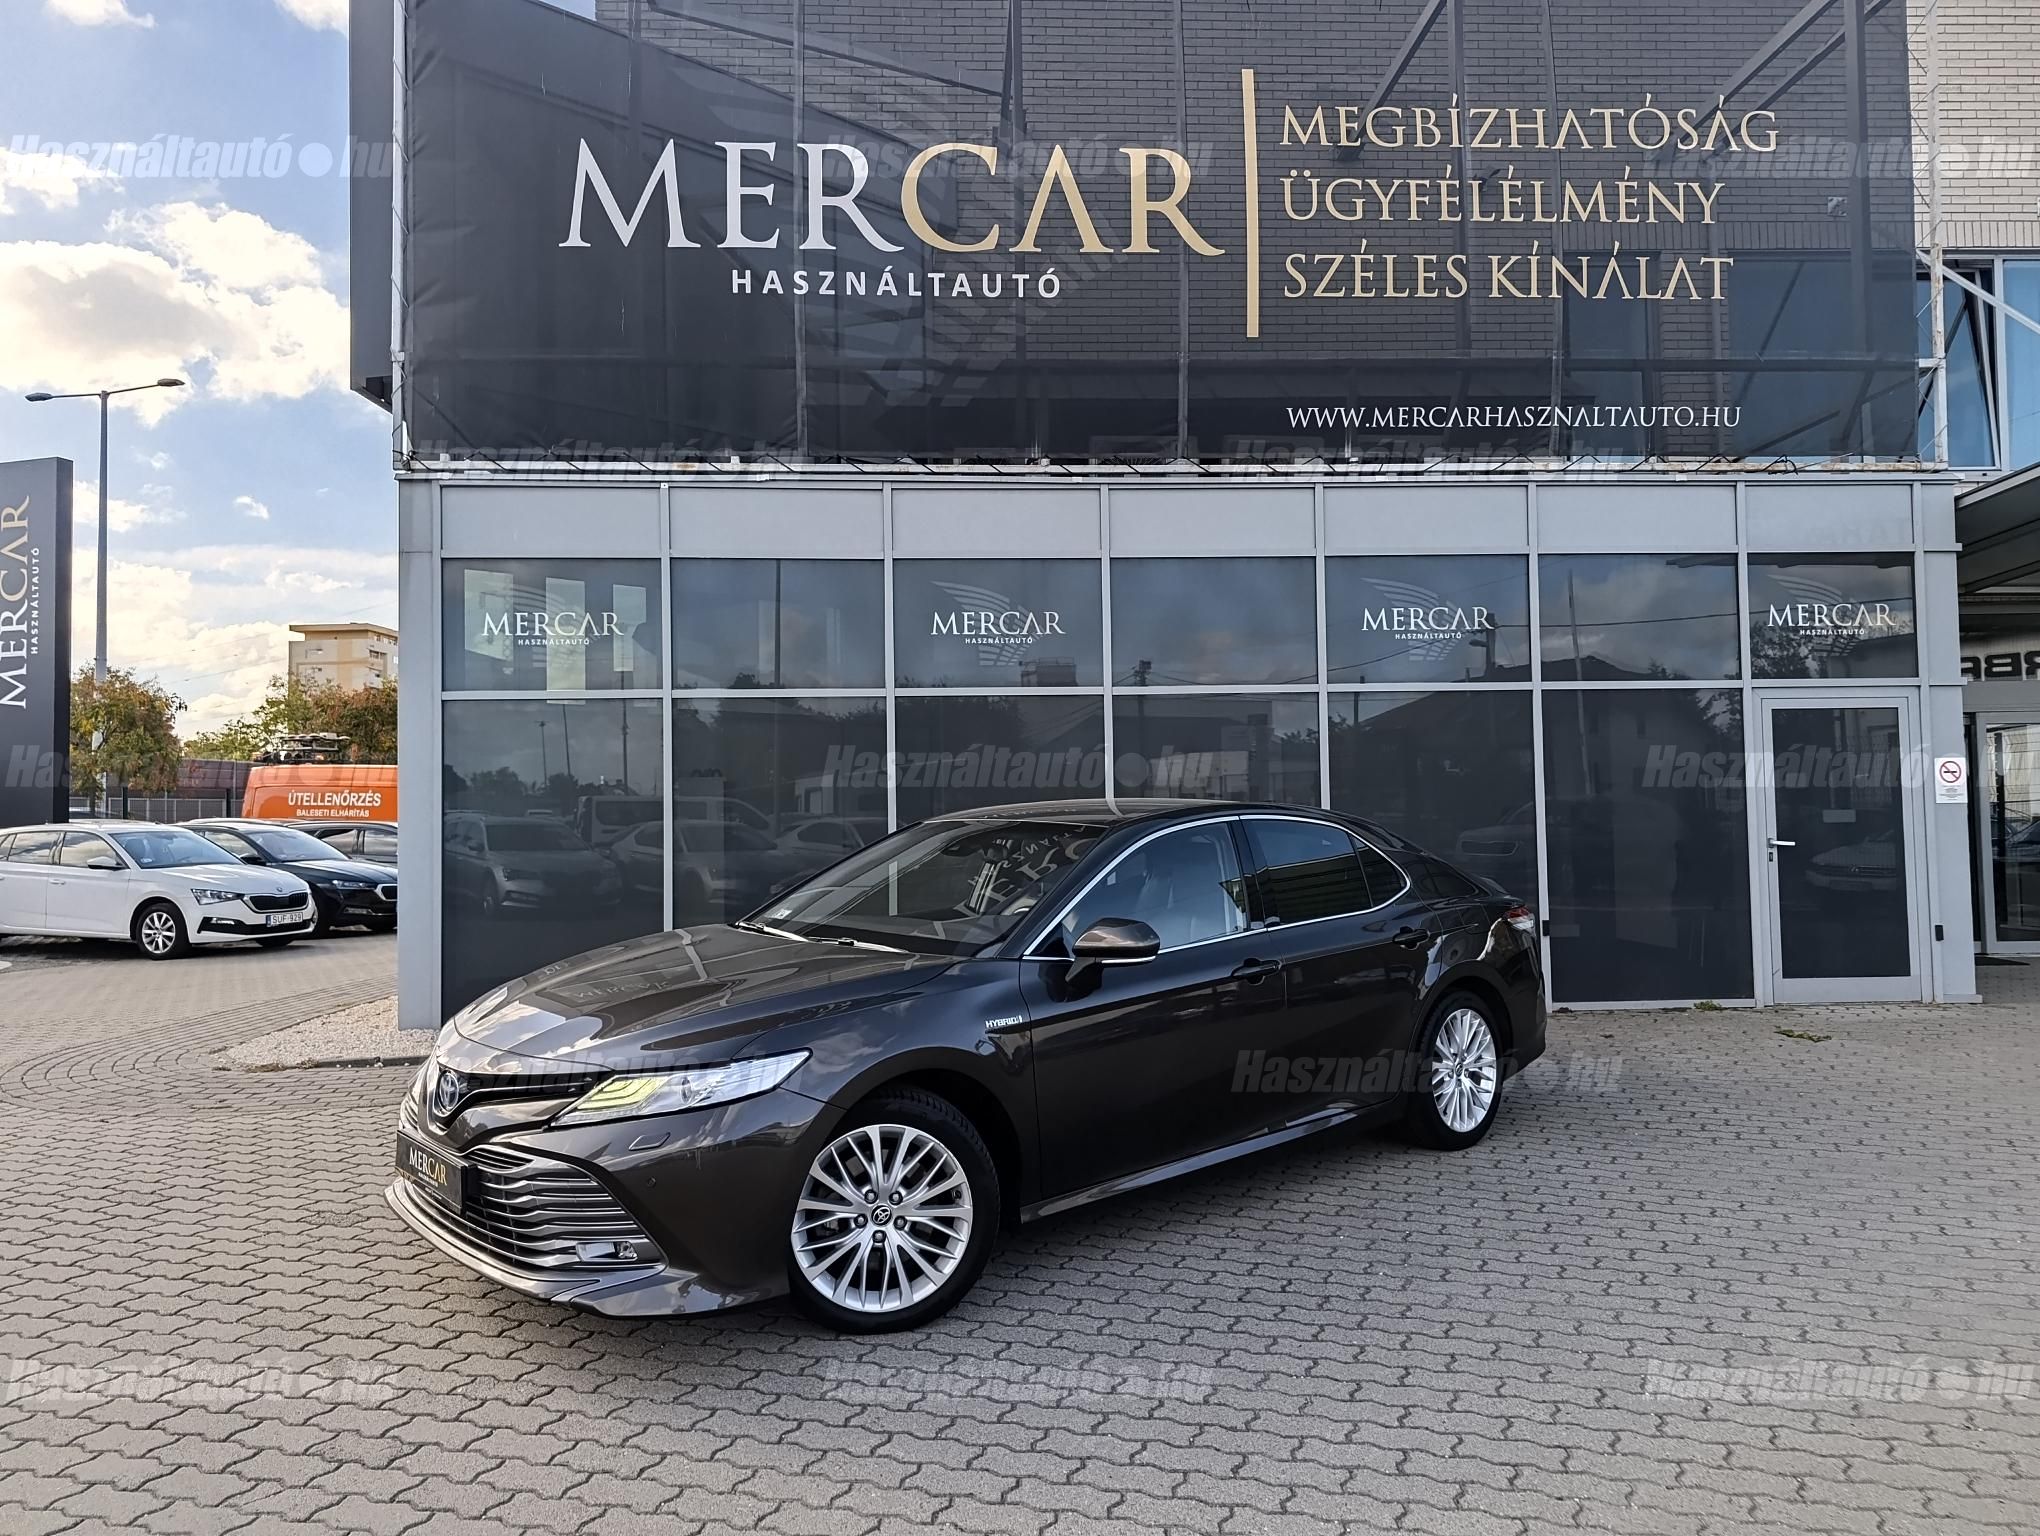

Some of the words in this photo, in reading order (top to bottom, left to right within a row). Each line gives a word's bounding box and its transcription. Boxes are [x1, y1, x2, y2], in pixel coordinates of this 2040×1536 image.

[1280, 92, 1779, 152] MEGBÍZHATÓSÁG
[558, 138, 1226, 256] MERCAR
[1280, 164, 1726, 224] ÜGYFÉLÉLMÉNY
[732, 267, 1061, 298] HASZNÁLTAUTÓ
[1284, 238, 1468, 298] SZÉLES
[1488, 240, 1734, 300] KÍNÁLAT
[1286, 406, 1742, 429] WWW.MERCARHASZNALTAUTO.HU
[0, 496, 30, 710] MERCAR
[30, 546, 41, 655] HASZNÁLTAUTÓ
[1767, 603, 1897, 627] MERCAR
[481, 611, 625, 636] MERCAR
[930, 611, 1066, 635] MERCAR
[1361, 606, 1496, 631] MERCAR
[288, 789, 382, 807] ÚTELLENŐRZÉS
[409, 1146, 448, 1186] MERCAR
